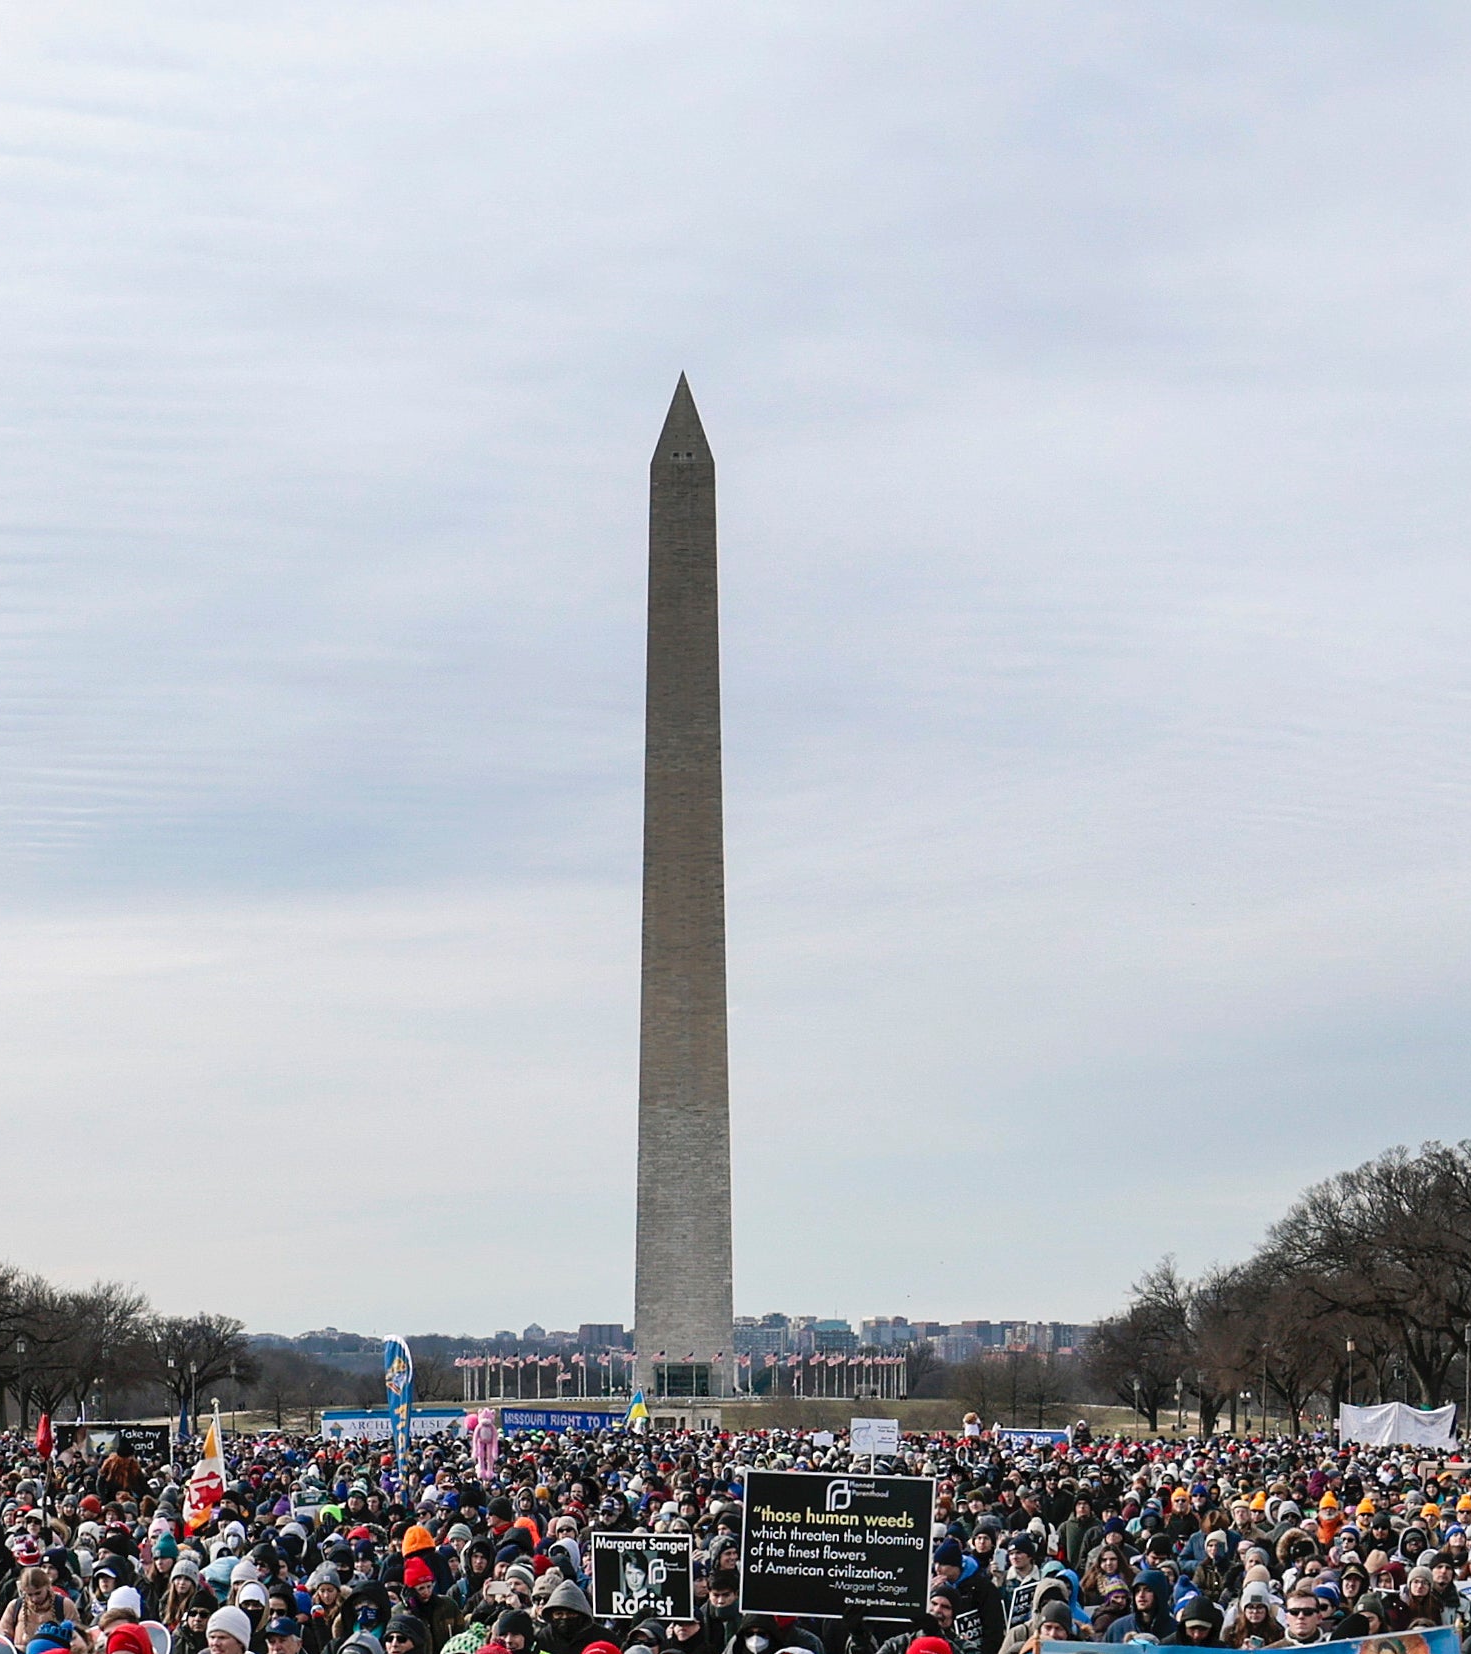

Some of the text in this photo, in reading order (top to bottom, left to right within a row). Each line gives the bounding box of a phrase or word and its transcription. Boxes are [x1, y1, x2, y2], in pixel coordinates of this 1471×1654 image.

[504, 1412, 600, 1427] MISSOURI RIGHT TO
[120, 1429, 161, 1439] Take my
[806, 1508, 859, 1526] human
[864, 1511, 915, 1528] weeds
[595, 1535, 689, 1555] Margaret Sanger
[751, 1525, 924, 1550] which threaten the blooming
[750, 1544, 867, 1562] of the finest flowers
[750, 1561, 763, 1575] of
[765, 1562, 824, 1577] American
[878, 1582, 908, 1595] Sanger
[612, 1591, 674, 1616] Racist
